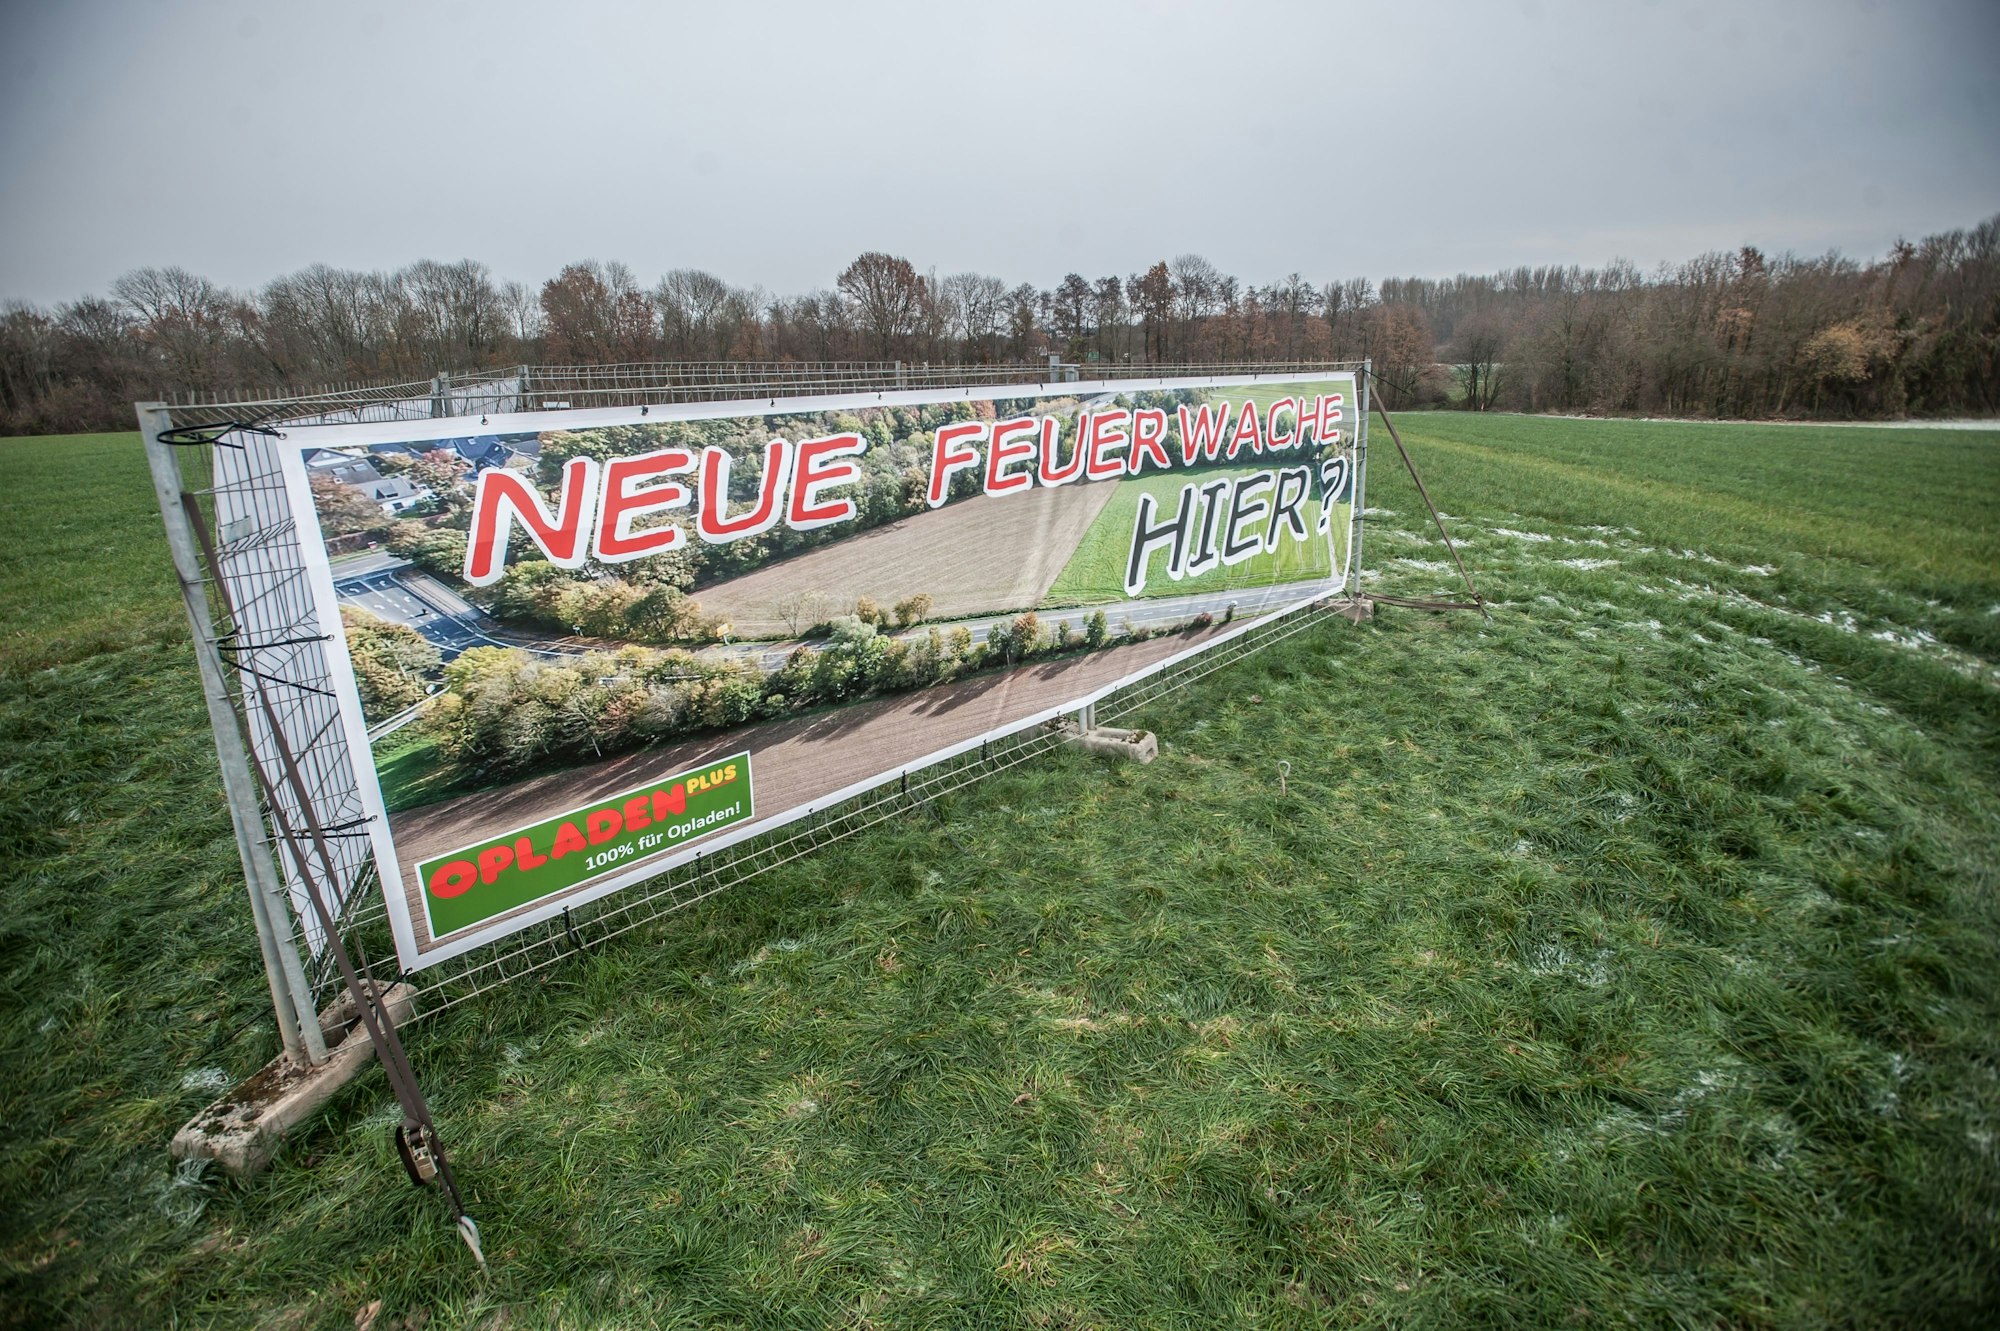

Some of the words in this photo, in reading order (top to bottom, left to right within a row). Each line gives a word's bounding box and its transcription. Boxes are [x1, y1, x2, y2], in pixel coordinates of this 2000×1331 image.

[468, 435, 860, 581] NEUE
[928, 393, 1344, 503] FEUERWACHE
[1126, 458, 1347, 588] HIER?
[429, 783, 687, 899] OPLADEN
[686, 764, 737, 795] PLUS
[585, 843, 635, 871] 100%
[637, 832, 664, 850] für
[667, 801, 741, 840] Opladen!
